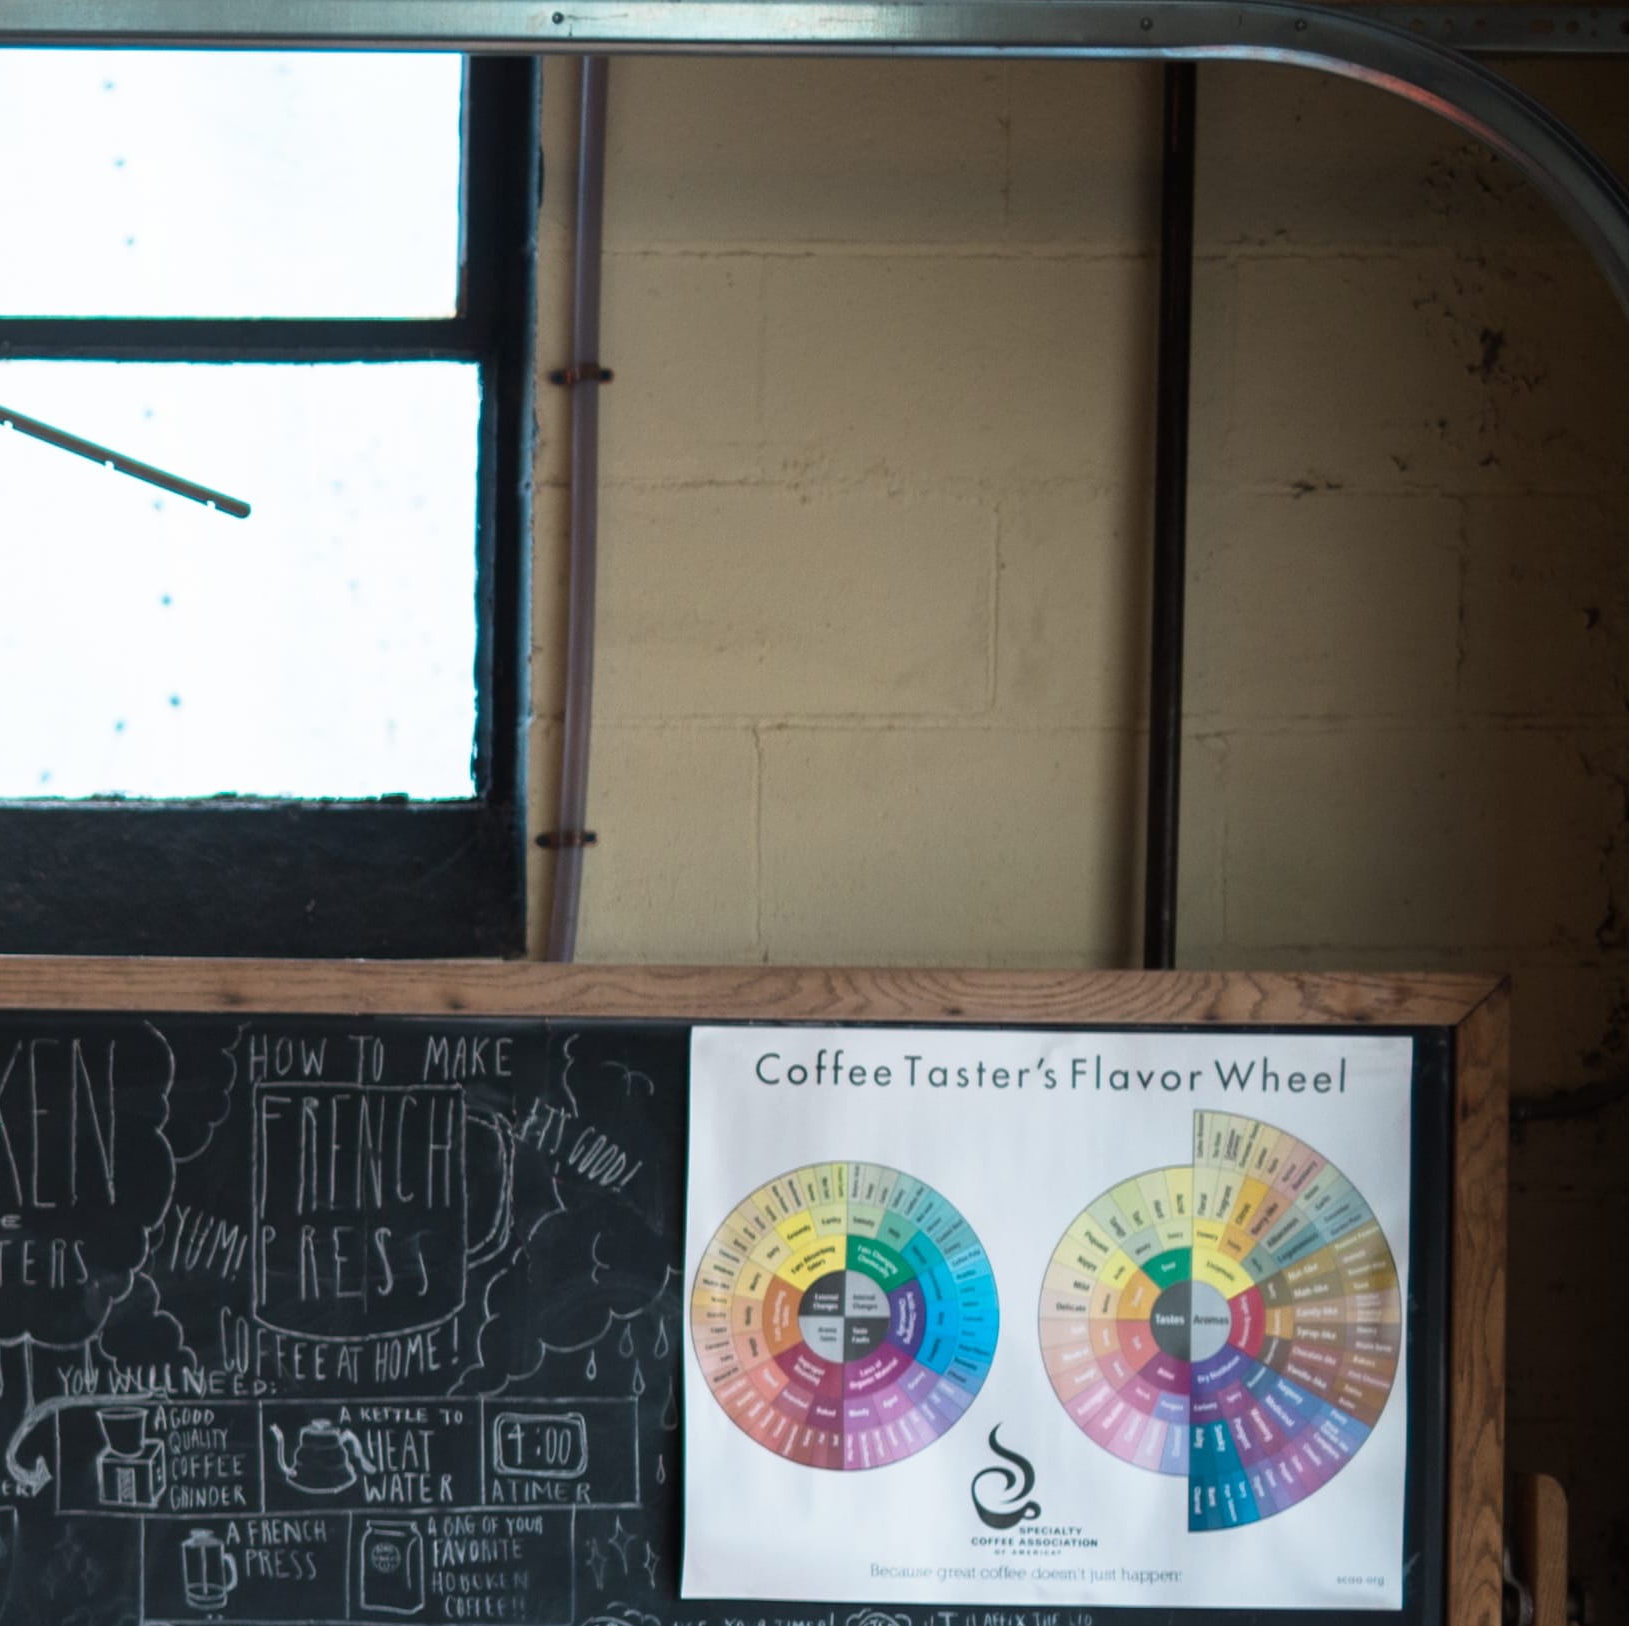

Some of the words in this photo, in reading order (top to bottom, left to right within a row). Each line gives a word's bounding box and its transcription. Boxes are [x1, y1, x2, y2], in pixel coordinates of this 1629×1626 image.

[249, 1035, 327, 1081] HOW
[349, 1035, 385, 1084] TO
[423, 1036, 514, 1080] MAKE
[755, 1049, 892, 1086] Coffee
[904, 1055, 1058, 1090] Taster's
[1071, 1054, 1202, 1092] Flavor
[1214, 1056, 1347, 1093] Wheel
[260, 1093, 457, 1218] FRENCH
[568, 1126, 643, 1192] GOOD!
[171, 1204, 249, 1280] YUM!
[260, 1226, 433, 1306] PRESS
[1155, 1312, 1185, 1326] Tastes
[1193, 1313, 1229, 1326] Aromas
[221, 1306, 325, 1380] COFFEE
[337, 1342, 364, 1383] AT
[374, 1316, 461, 1382] HOME!
[58, 1364, 99, 1397] YOU
[109, 1364, 172, 1396] WILL
[182, 1364, 277, 1397] NEED:
[154, 1405, 167, 1431] A
[169, 1407, 215, 1430] GOOD
[340, 1405, 352, 1424] A
[359, 1406, 429, 1423] KETTLE
[438, 1408, 464, 1425] TO
[167, 1427, 229, 1454] QUALITY
[366, 1429, 435, 1473] HEAT
[171, 1452, 246, 1480] COFFEE
[169, 1484, 247, 1511] GRINDER
[363, 1473, 454, 1502] WATER
[492, 1478, 505, 1502] A
[507, 1480, 592, 1504] TIMER
[225, 1519, 241, 1545] A
[246, 1518, 329, 1546] FRENCH
[443, 1515, 476, 1535] BAG
[481, 1515, 500, 1535] OF
[504, 1514, 544, 1536] YOUR
[1018, 1526, 1083, 1536] SPECIALTY
[432, 1537, 524, 1569] FAVORITE
[970, 1536, 1014, 1547] COFFEE
[1018, 1536, 1099, 1548] ASSOCIATION
[245, 1547, 318, 1580] PRESS
[869, 1563, 933, 1579] Because
[935, 1566, 976, 1583] great
[979, 1564, 1028, 1581] coffee
[1030, 1565, 1086, 1582] doesn't
[1089, 1566, 1118, 1585] just
[431, 1569, 529, 1597] HOBOKEN
